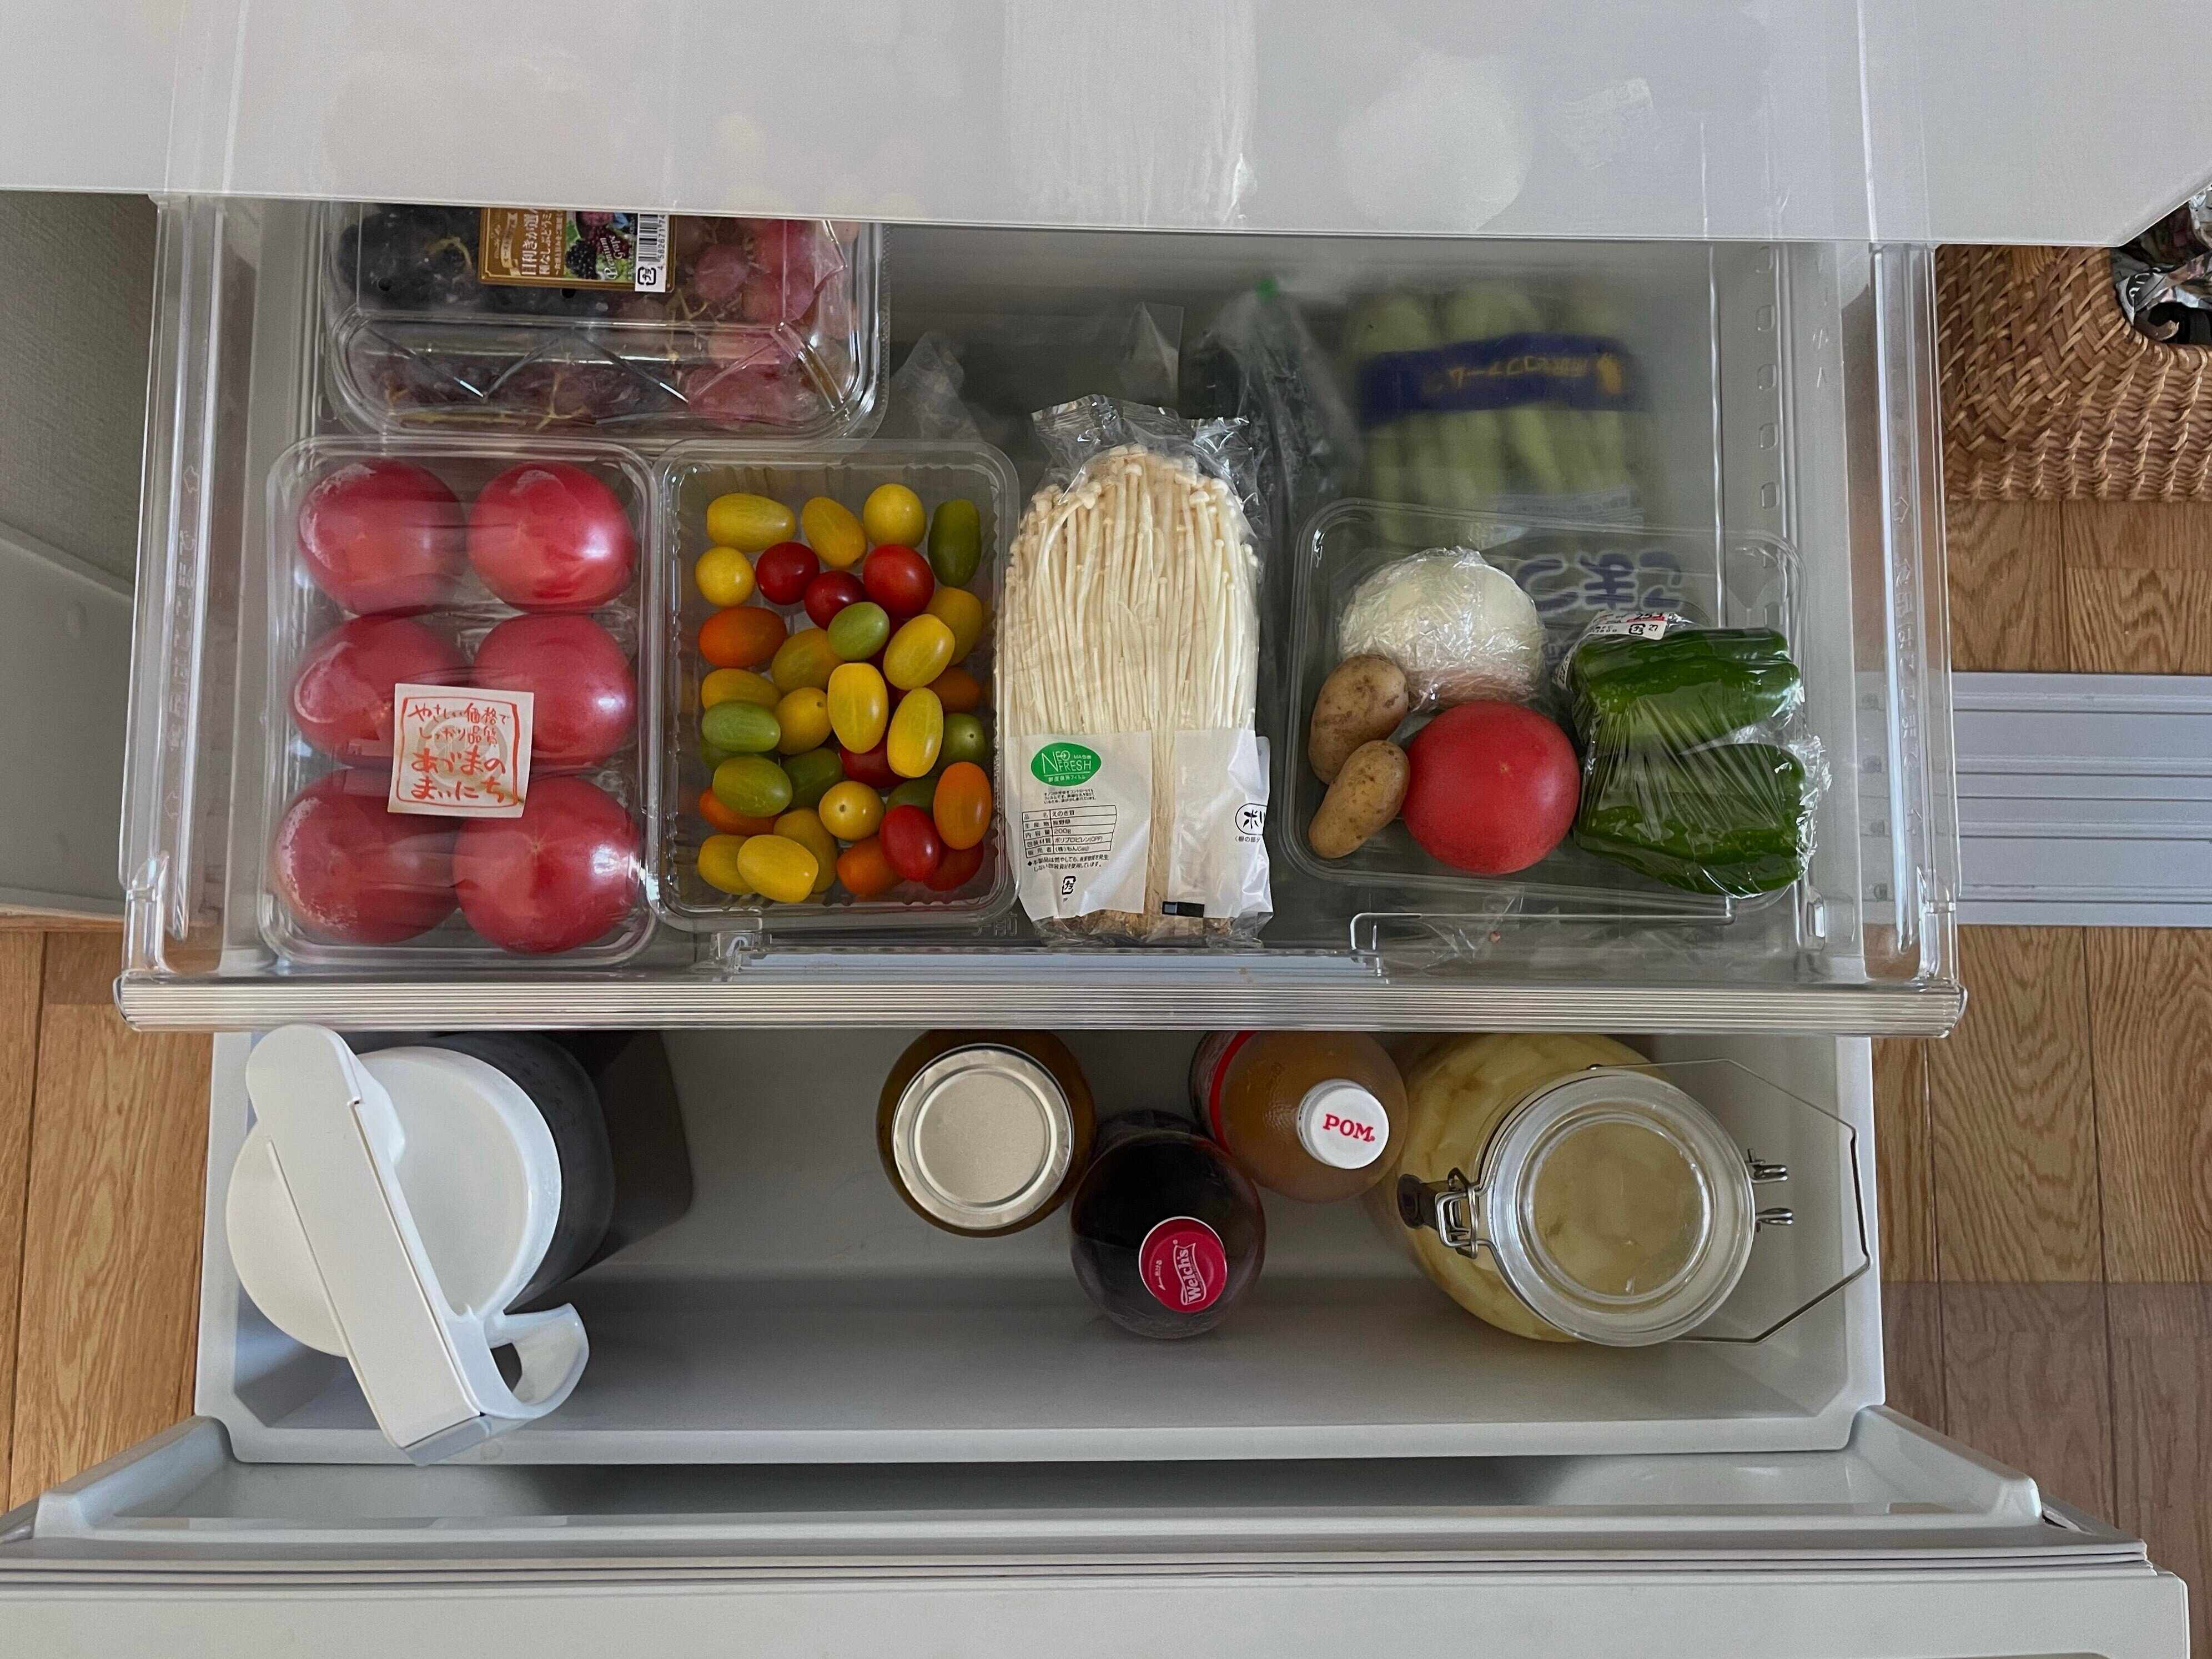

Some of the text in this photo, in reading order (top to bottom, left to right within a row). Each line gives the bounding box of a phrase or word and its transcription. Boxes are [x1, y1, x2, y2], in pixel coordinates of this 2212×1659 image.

[600, 237, 618, 280] Premium
[609, 235, 625, 259] Grape
[407, 702, 511, 725] やさしい価格で
[411, 745, 506, 776] あづまの
[1059, 760, 1092, 772] FRESH
[410, 776, 505, 803] まいにち
[1178, 1248, 1202, 1302] Welch's
